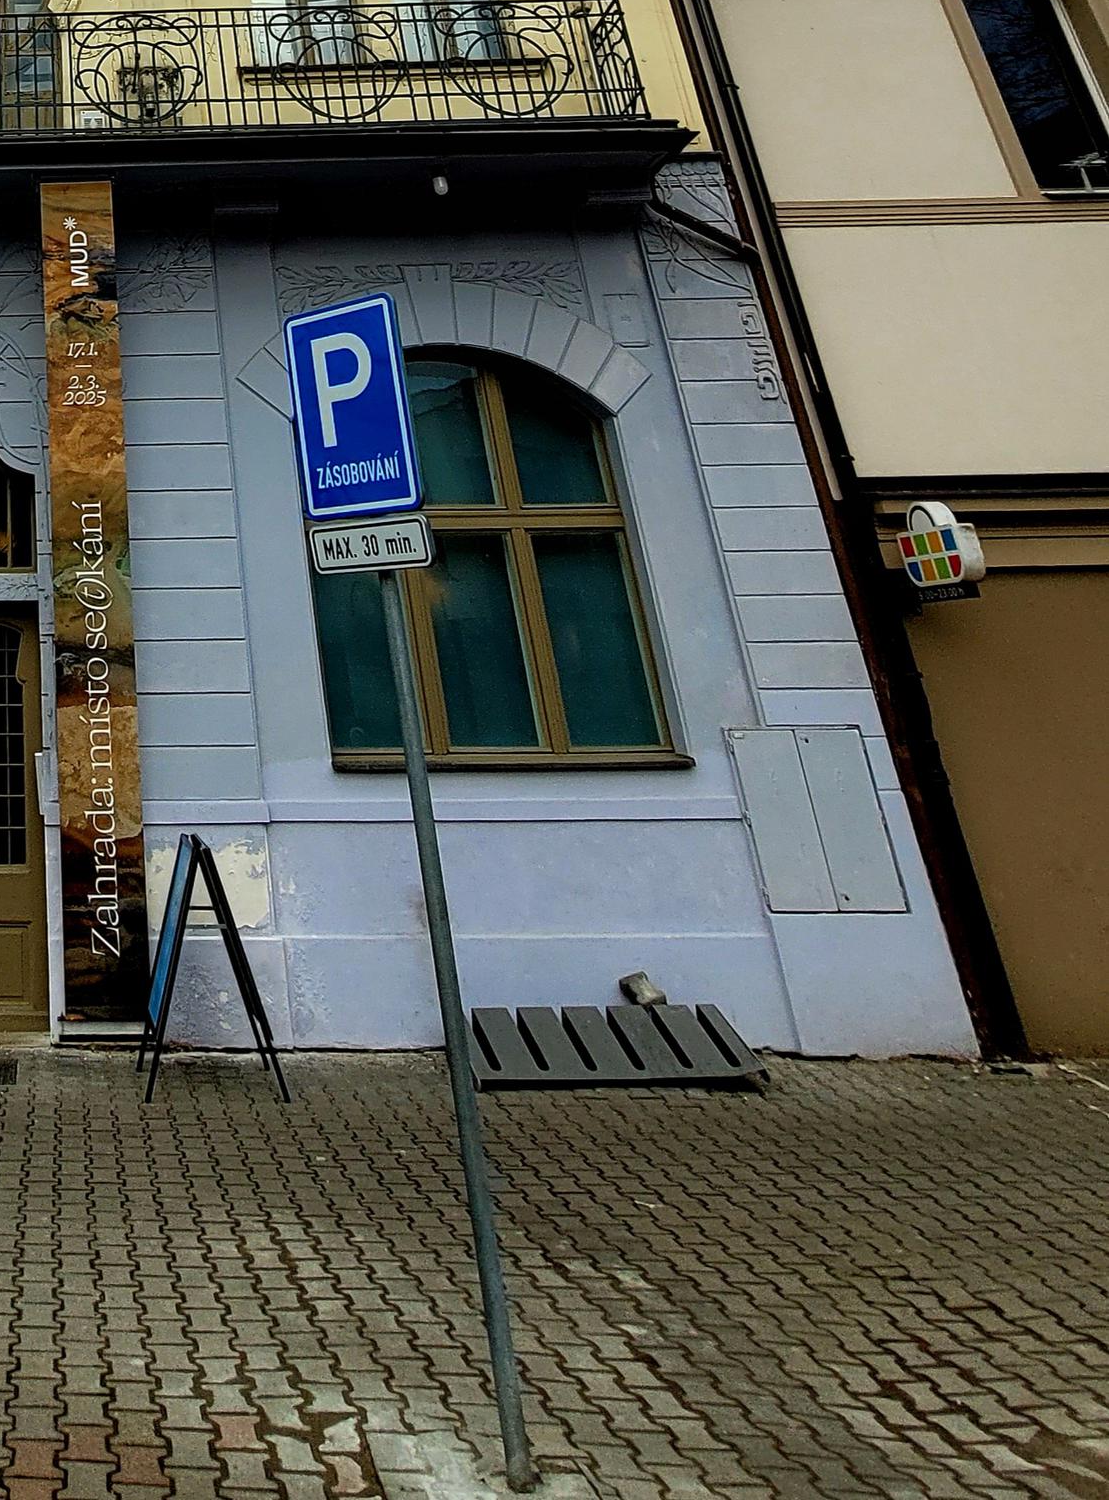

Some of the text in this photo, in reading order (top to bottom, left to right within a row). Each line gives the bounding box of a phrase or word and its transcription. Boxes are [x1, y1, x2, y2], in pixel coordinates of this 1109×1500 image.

[62, 390, 107, 407] 2025
[310, 332, 372, 448] P
[317, 450, 401, 489] ZÁSOBOVÁNÍ
[322, 531, 417, 561] MAX. 30 min.
[79, 658, 113, 770] místo
[84, 777, 120, 958] Zahrada:
